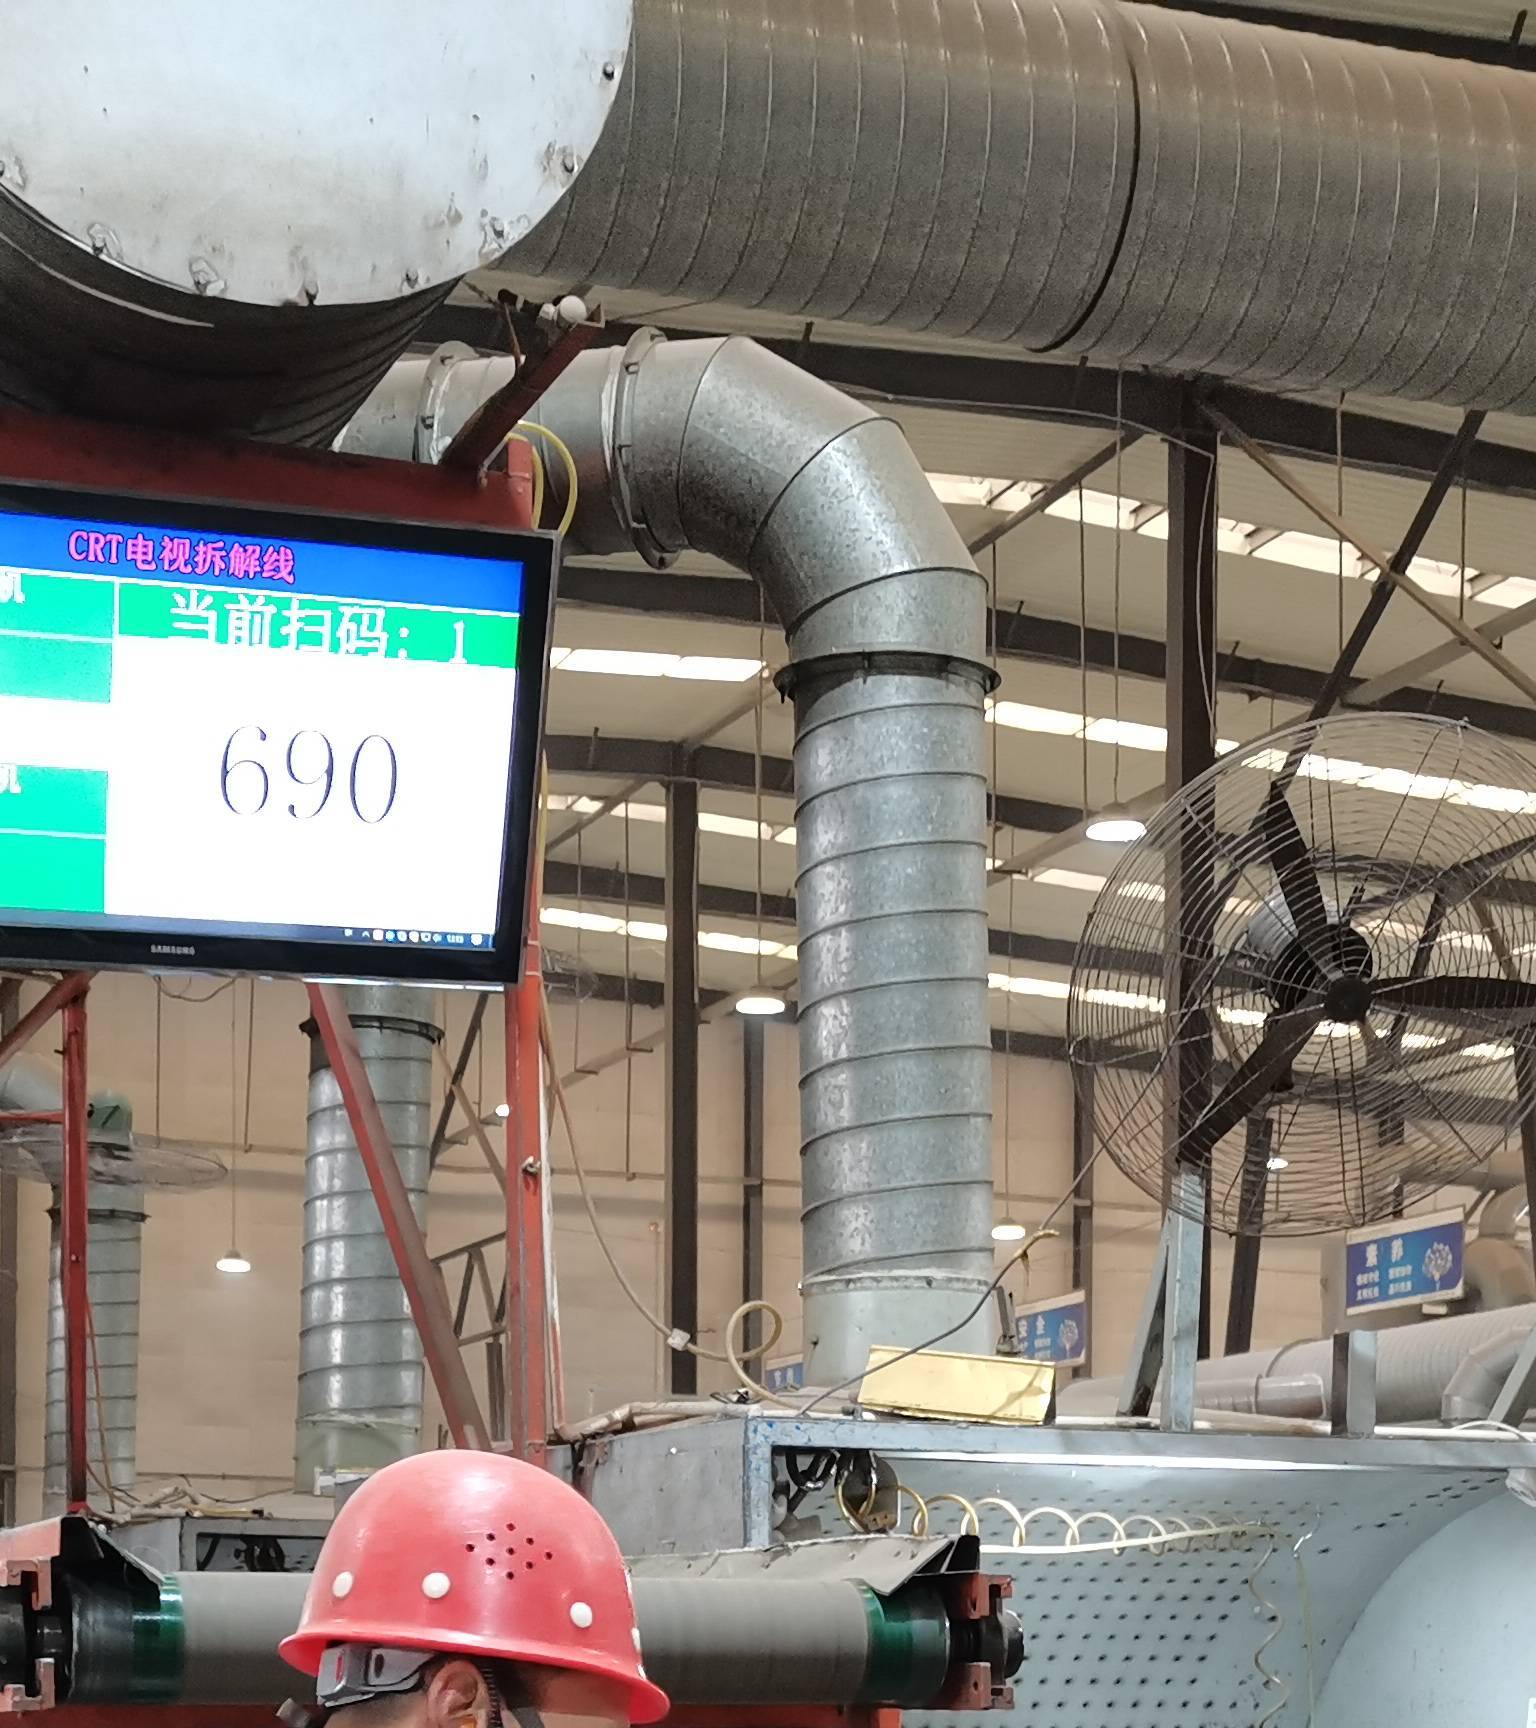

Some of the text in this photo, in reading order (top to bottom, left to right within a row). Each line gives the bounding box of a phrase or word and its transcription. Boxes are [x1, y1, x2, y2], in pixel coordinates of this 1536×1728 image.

[68, 529, 296, 584] CRT电视拆解线
[220, 725, 398, 824] 690
